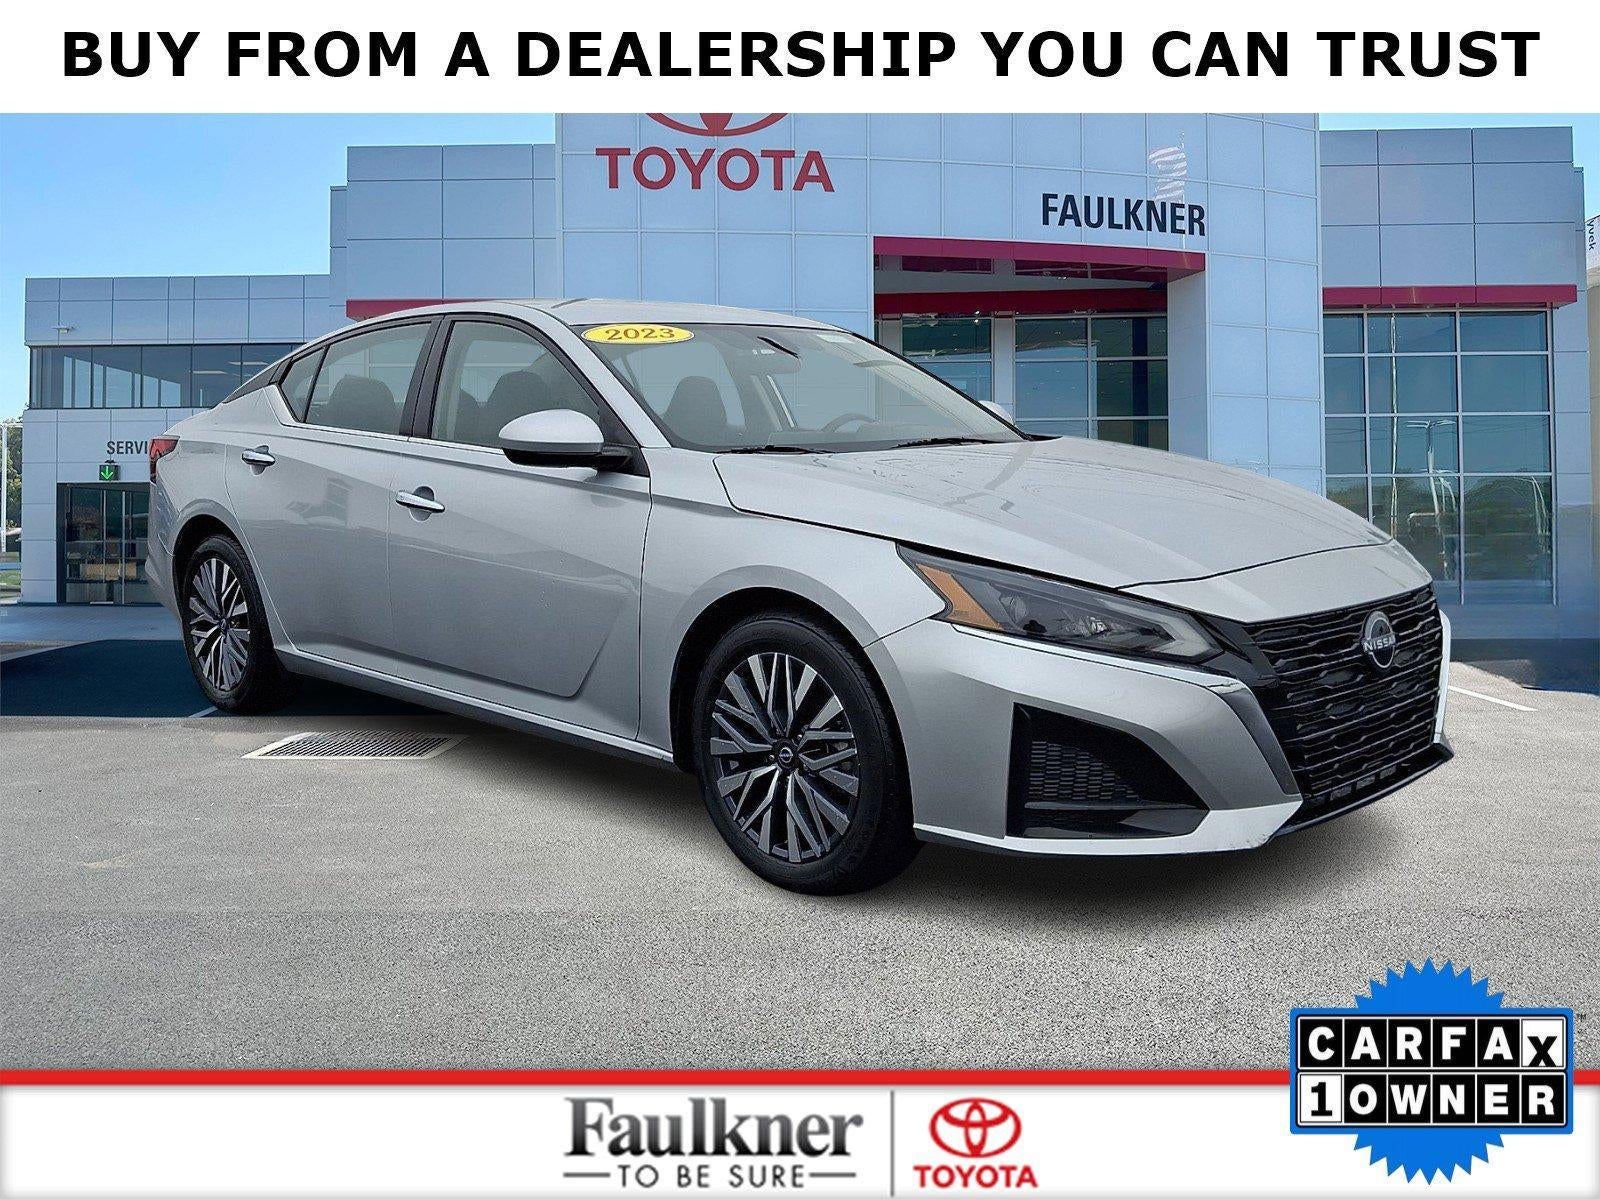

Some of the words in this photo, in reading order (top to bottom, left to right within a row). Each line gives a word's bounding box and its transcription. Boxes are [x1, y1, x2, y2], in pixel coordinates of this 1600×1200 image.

[596, 147, 834, 192] TOYOTA
[1042, 194, 1205, 236] FAULKNER
[1586, 219, 1597, 251] yvek
[605, 328, 675, 340] 2023
[106, 440, 147, 455] SERVI
